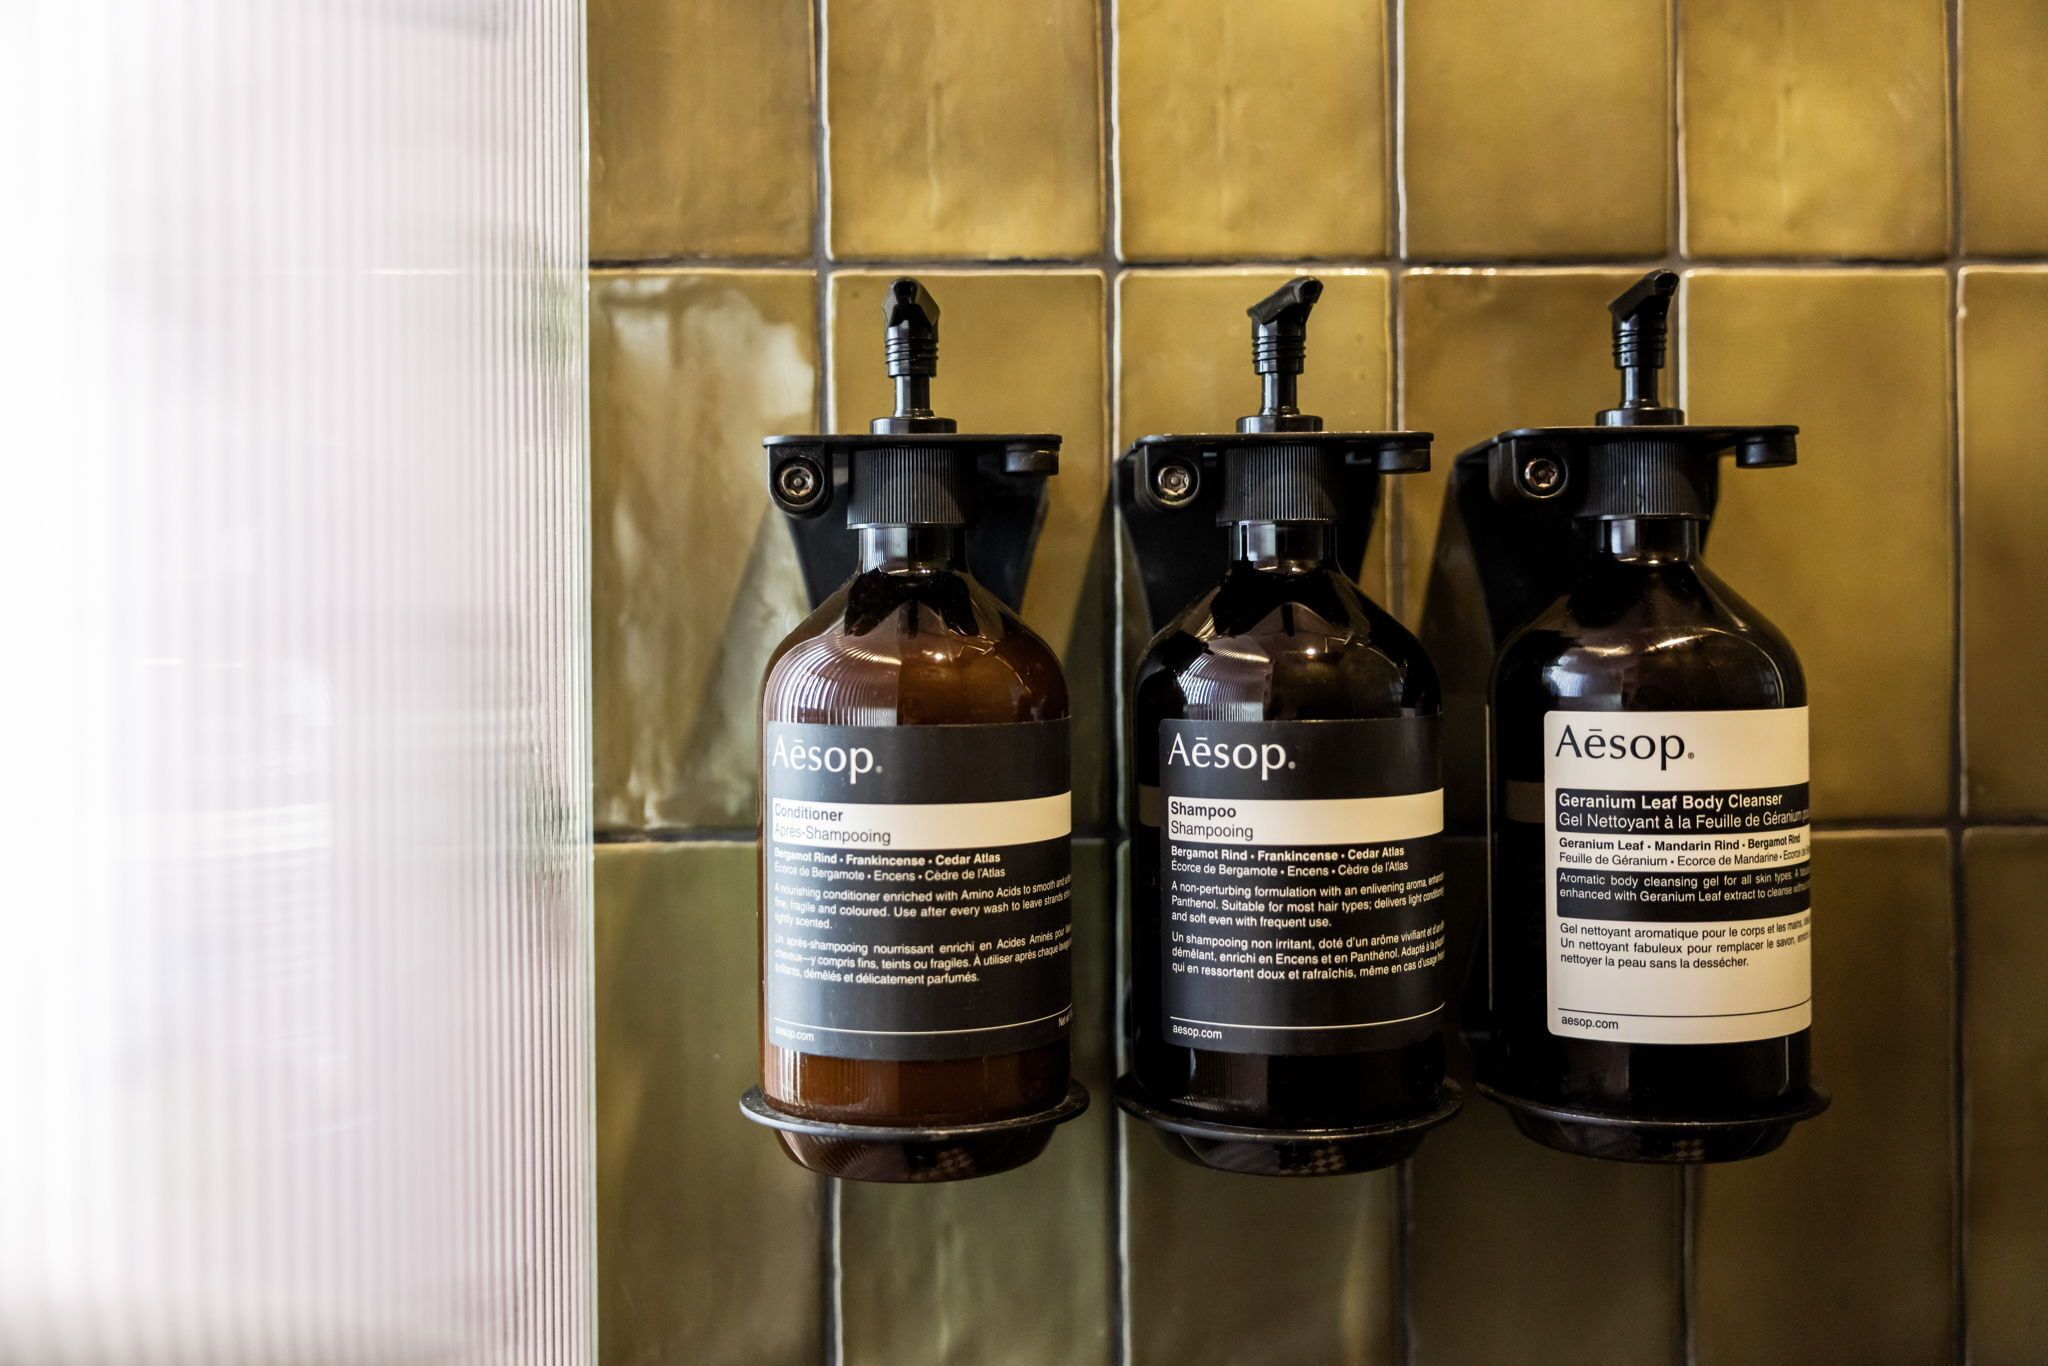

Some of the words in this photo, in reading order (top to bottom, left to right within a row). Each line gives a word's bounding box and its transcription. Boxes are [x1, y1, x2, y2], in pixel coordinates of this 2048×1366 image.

[1171, 801, 1237, 820] Shampoo
[1559, 793, 1636, 809] Geranium
[1641, 795, 1677, 809] Leaf
[1682, 795, 1724, 812] Body
[1728, 794, 1783, 808] Cleanser
[775, 803, 844, 821] Conditioner
[1171, 820, 1254, 841] Shampooing
[1559, 812, 1582, 826] Gel
[1587, 813, 1660, 832] Nettoyant
[1664, 815, 1674, 829] à
[1678, 815, 1692, 829] la
[1696, 814, 1742, 829] Feuille
[1745, 813, 1760, 827] de
[775, 823, 891, 846] Après-Shampooing
[1559, 837, 1614, 850] Geranium
[1618, 840, 1644, 851] Leaf
[1655, 841, 1711, 851] Mandarin
[1714, 840, 1739, 850] Rind
[1748, 836, 1787, 850] Bergamot
[774, 847, 811, 862] Bergamot
[814, 852, 837, 864] Rind
[846, 854, 925, 866] Frankincense
[935, 854, 971, 865] Cedar
[974, 853, 1001, 864] Atlas
[1171, 846, 1218, 860] Bergamot
[1221, 849, 1248, 860] Rind
[1257, 850, 1338, 861] Frankincense
[1347, 849, 1379, 860] Cedar
[1382, 847, 1404, 858] Atlas
[1559, 852, 1592, 864] Feuille
[1595, 854, 1609, 865] de
[1612, 854, 1668, 866] Géranium
[1677, 856, 1716, 866] Ecorce
[1718, 855, 1731, 866] de
[1734, 853, 1778, 865] Mandarine
[800, 866, 809, 877] de
[812, 867, 865, 881] Bergamote
[874, 870, 915, 881] Encens
[925, 869, 959, 881] Cèdre
[961, 868, 975, 880] de
[977, 867, 1005, 879] l'Atlas
[1171, 858, 1201, 873] Écorce
[1203, 863, 1216, 874] de
[1219, 864, 1278, 878] Bergamote
[1287, 865, 1329, 877] Encens
[1338, 864, 1369, 876] Cèdre
[1371, 863, 1383, 873] de
[1385, 861, 1408, 872] l'Atlas
[1180, 883, 1252, 899] non-perturbing
[1254, 886, 1316, 897] formulation
[1320, 886, 1341, 896] with
[1344, 886, 1358, 896] an
[1360, 881, 1404, 895] enlivening
[1406, 879, 1427, 890] aroma,
[1560, 872, 1606, 885] Aromatic
[1611, 875, 1639, 888] body
[1644, 876, 1698, 889] cleansing
[1703, 876, 1719, 888] gel
[1724, 874, 1737, 885] for
[1741, 874, 1752, 885] all
[1755, 873, 1772, 884] skin
[1774, 871, 1793, 884] types.
[822, 890, 880, 901] conditioner
[883, 890, 932, 901] enriched
[936, 890, 958, 901] with
[961, 889, 994, 900] Amino
[996, 886, 1021, 898] Acids
[1560, 888, 1611, 900] enhanced
[1614, 890, 1637, 901] with
[1640, 890, 1695, 902] Geranium
[1699, 890, 1722, 902] Leaf
[1724, 889, 1755, 901] extract
[1767, 886, 1793, 898] cleanse
[790, 901, 816, 914] fragile
[840, 905, 890, 917] coloured.
[894, 906, 916, 917] Use
[921, 906, 946, 917] after
[950, 905, 980, 917] every
[983, 902, 1009, 914] wash
[1171, 895, 1218, 910] Panthenol.
[1221, 900, 1265, 911] Suitable
[1268, 901, 1283, 912] for
[1287, 902, 1314, 912] most
[1318, 901, 1338, 912] hair
[1341, 900, 1372, 913] types;
[1374, 897, 1406, 909] delivers
[1408, 894, 1422, 906] light
[795, 916, 832, 929] scented.
[1171, 911, 1187, 921] and
[1189, 913, 1206, 924] soft
[1209, 916, 1233, 925] even
[1235, 916, 1257, 927] with
[1260, 916, 1306, 929] frequent
[1308, 918, 1332, 927] use.
[1172, 931, 1183, 942] Un
[1186, 934, 1248, 950] shampooing
[1251, 940, 1272, 949] non
[1275, 938, 1315, 950] irritant,
[1318, 938, 1343, 949] doté
[1346, 937, 1368, 948] d'un
[1370, 934, 1399, 946] arôme
[1401, 929, 1426, 942] vivifiant
[1560, 922, 1578, 934] Gel
[1580, 925, 1631, 939] nettoyant
[1634, 928, 1699, 940] aromatique
[1701, 929, 1726, 940] pour
[1740, 926, 1766, 938] corps
[873, 944, 934, 954] nourrissant
[940, 941, 975, 953] enrichi
[997, 938, 1026, 949] Acides
[1172, 946, 1217, 962] démêlant,
[1220, 952, 1256, 963] enrichi
[1275, 953, 1319, 965] Encens
[1350, 948, 1400, 963] Panthénol.
[1401, 942, 1425, 957] Adapté
[1560, 937, 1574, 948] Un
[1579, 940, 1629, 954] nettoyant
[1634, 942, 1682, 953] fabuleux
[1687, 945, 1712, 955] pour
[1716, 941, 1764, 954] remplacer
[1776, 936, 1796, 947] savon,
[817, 956, 855, 969] compris
[857, 957, 879, 969] fins,
[882, 958, 911, 969] teints
[930, 957, 971, 970] fragiles.
[983, 953, 1015, 966] utiliser
[1015, 950, 1036, 964] après
[1560, 953, 1602, 967] nettoyer
[1618, 958, 1647, 969] peau
[1649, 959, 1677, 969] sans
[1693, 957, 1749, 969] dessécher.
[803, 968, 841, 981] démêlés
[855, 972, 924, 984] délicatement
[927, 971, 979, 986] parfumés.
[1172, 962, 1185, 973] qui
[1201, 966, 1254, 979] ressortent
[1256, 968, 1285, 979] doux
[1302, 967, 1357, 979] rafraîchis,
[1359, 964, 1389, 977] même
[1403, 961, 1417, 971] cas
[1561, 1016, 1619, 1029] aesop.com
[775, 1026, 815, 1041] aesop.com
[1173, 1025, 1223, 1039] aesop.com
